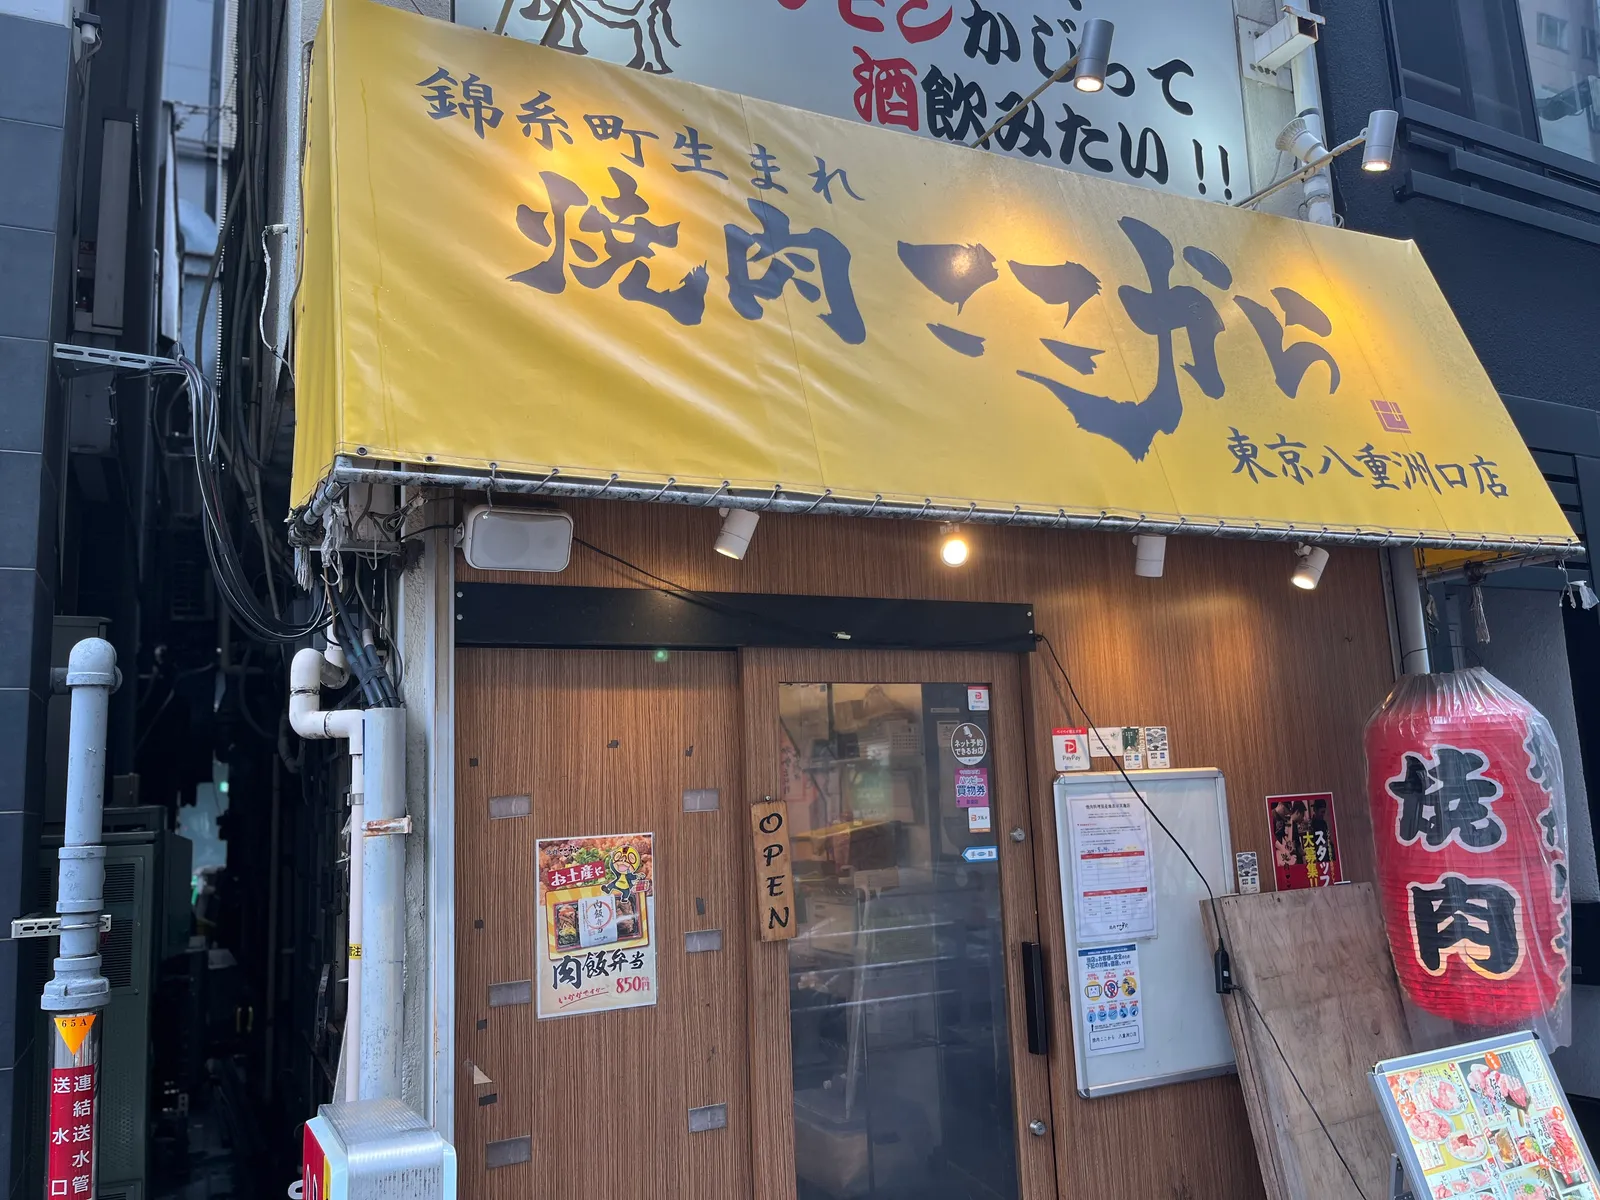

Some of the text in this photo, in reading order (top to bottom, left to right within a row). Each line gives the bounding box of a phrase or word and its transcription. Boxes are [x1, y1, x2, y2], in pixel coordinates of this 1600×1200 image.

[415, 66, 865, 205] 錦糸町生まれ
[1227, 426, 1510, 498] 東京八重洲口店
[954, 738, 984, 747] ネット予約
[954, 747, 984, 755] できるお店
[1062, 754, 1081, 762] PayPay
[957, 784, 986, 797] 買物券
[551, 864, 604, 887] お土産に
[759, 812, 789, 930] OPEN
[1314, 830, 1330, 887] スタッフ
[1386, 745, 1522, 979] 焼肉
[552, 947, 645, 990] 肉飯弁当
[616, 975, 650, 994] 850円
[61, 1018, 87, 1028] 65A
[51, 1077, 71, 1197] 送水口
[72, 1074, 91, 1194] 連結送水管
